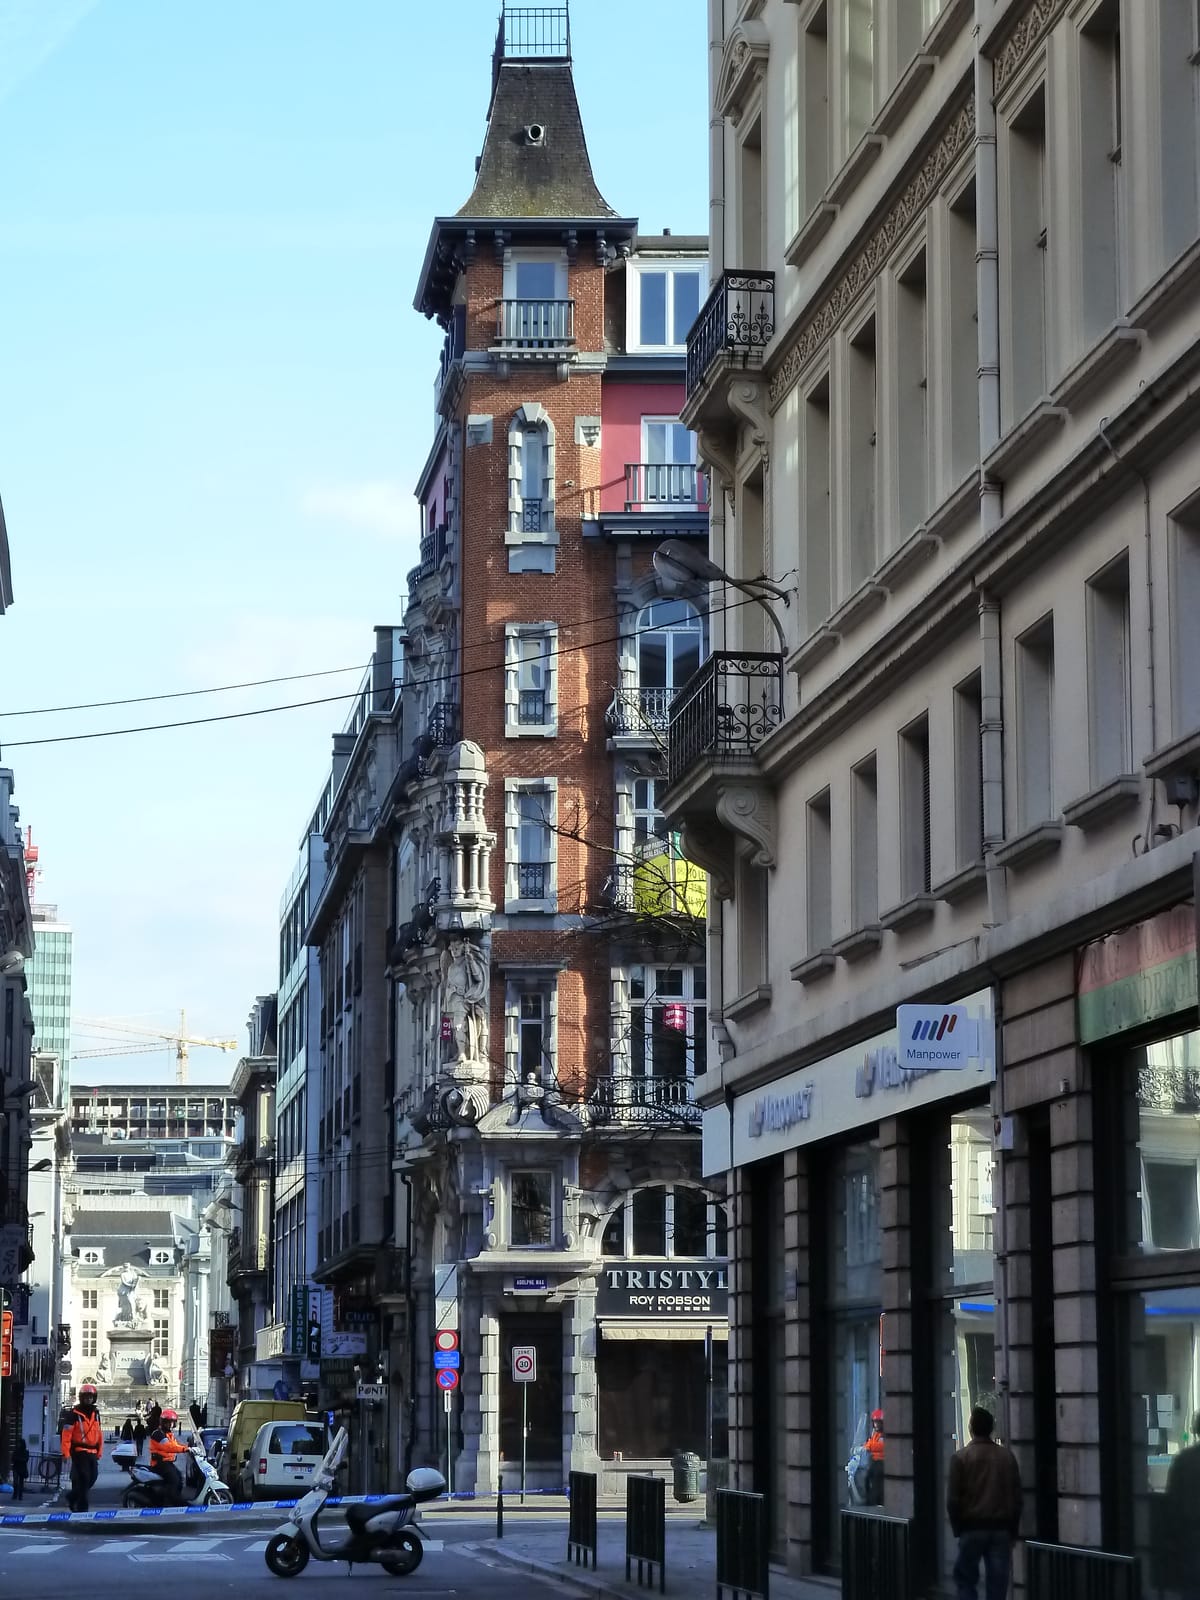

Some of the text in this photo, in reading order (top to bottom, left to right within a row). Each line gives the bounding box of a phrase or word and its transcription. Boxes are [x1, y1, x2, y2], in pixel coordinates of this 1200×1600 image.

[906, 1049, 961, 1061] Manpower
[629, 1295, 711, 1305] ROY ROBSON
[296, 1285, 304, 1353] RESTAURANT
[519, 1360, 529, 1368] 30
